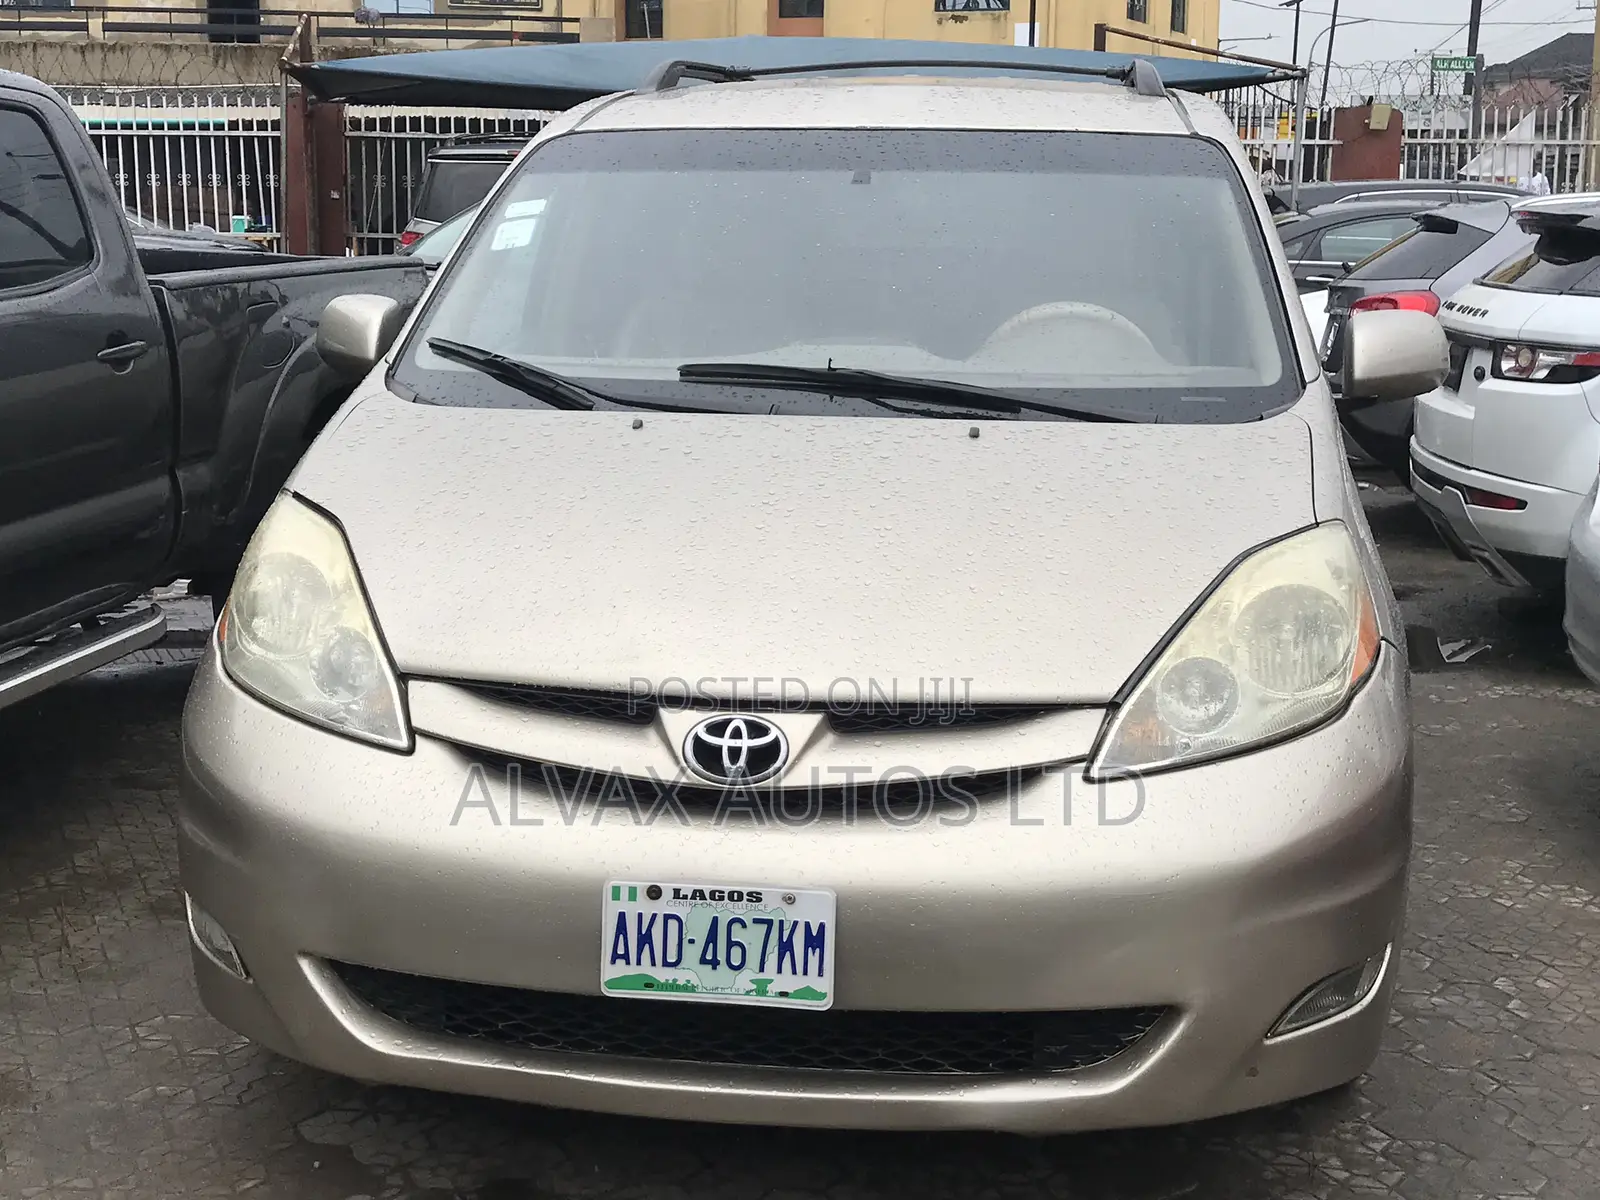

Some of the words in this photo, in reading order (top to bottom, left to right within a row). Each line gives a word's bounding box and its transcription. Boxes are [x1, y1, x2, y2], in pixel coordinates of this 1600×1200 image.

[672, 888, 763, 903] LAGOS
[666, 899, 698, 908] CENTRE
[701, 901, 714, 909] OF
[715, 902, 768, 911] EXCELLENCE
[610, 911, 826, 977] AKD-467KM
